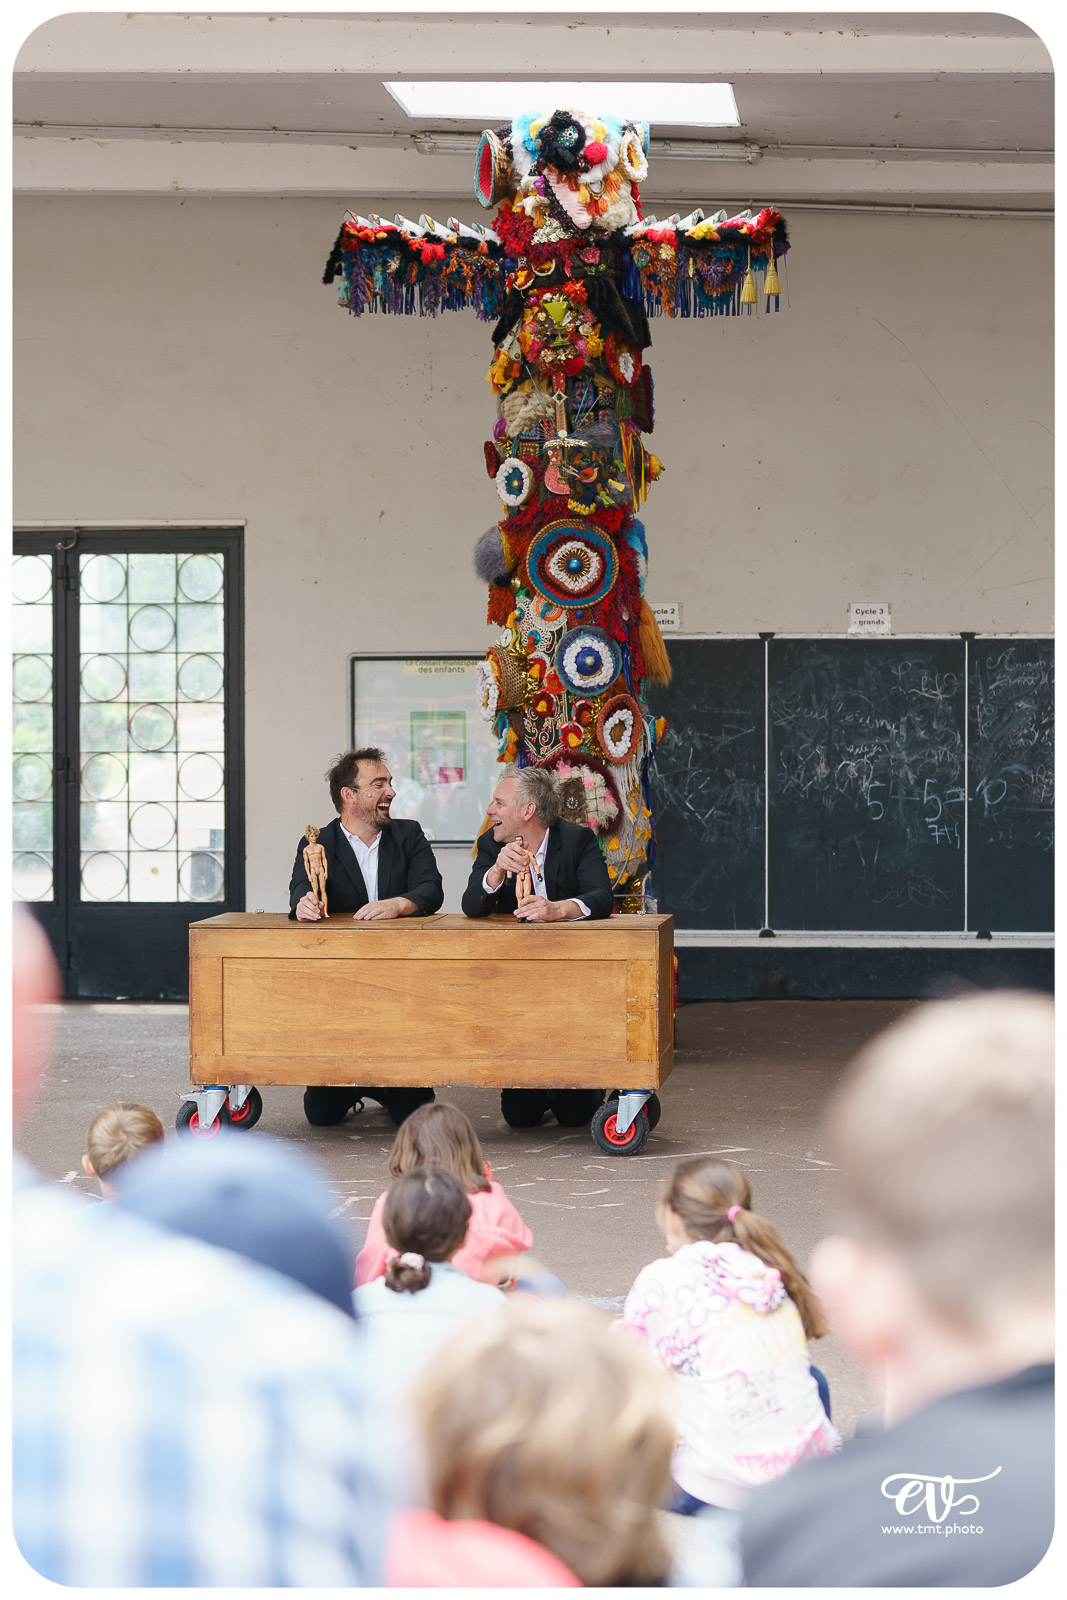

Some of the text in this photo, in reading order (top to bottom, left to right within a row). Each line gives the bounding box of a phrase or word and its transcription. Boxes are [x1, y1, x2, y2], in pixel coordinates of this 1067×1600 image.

[855, 608, 877, 616] Cycle
[418, 666, 466, 674] des enfants
[923, 779, 942, 823] 5
